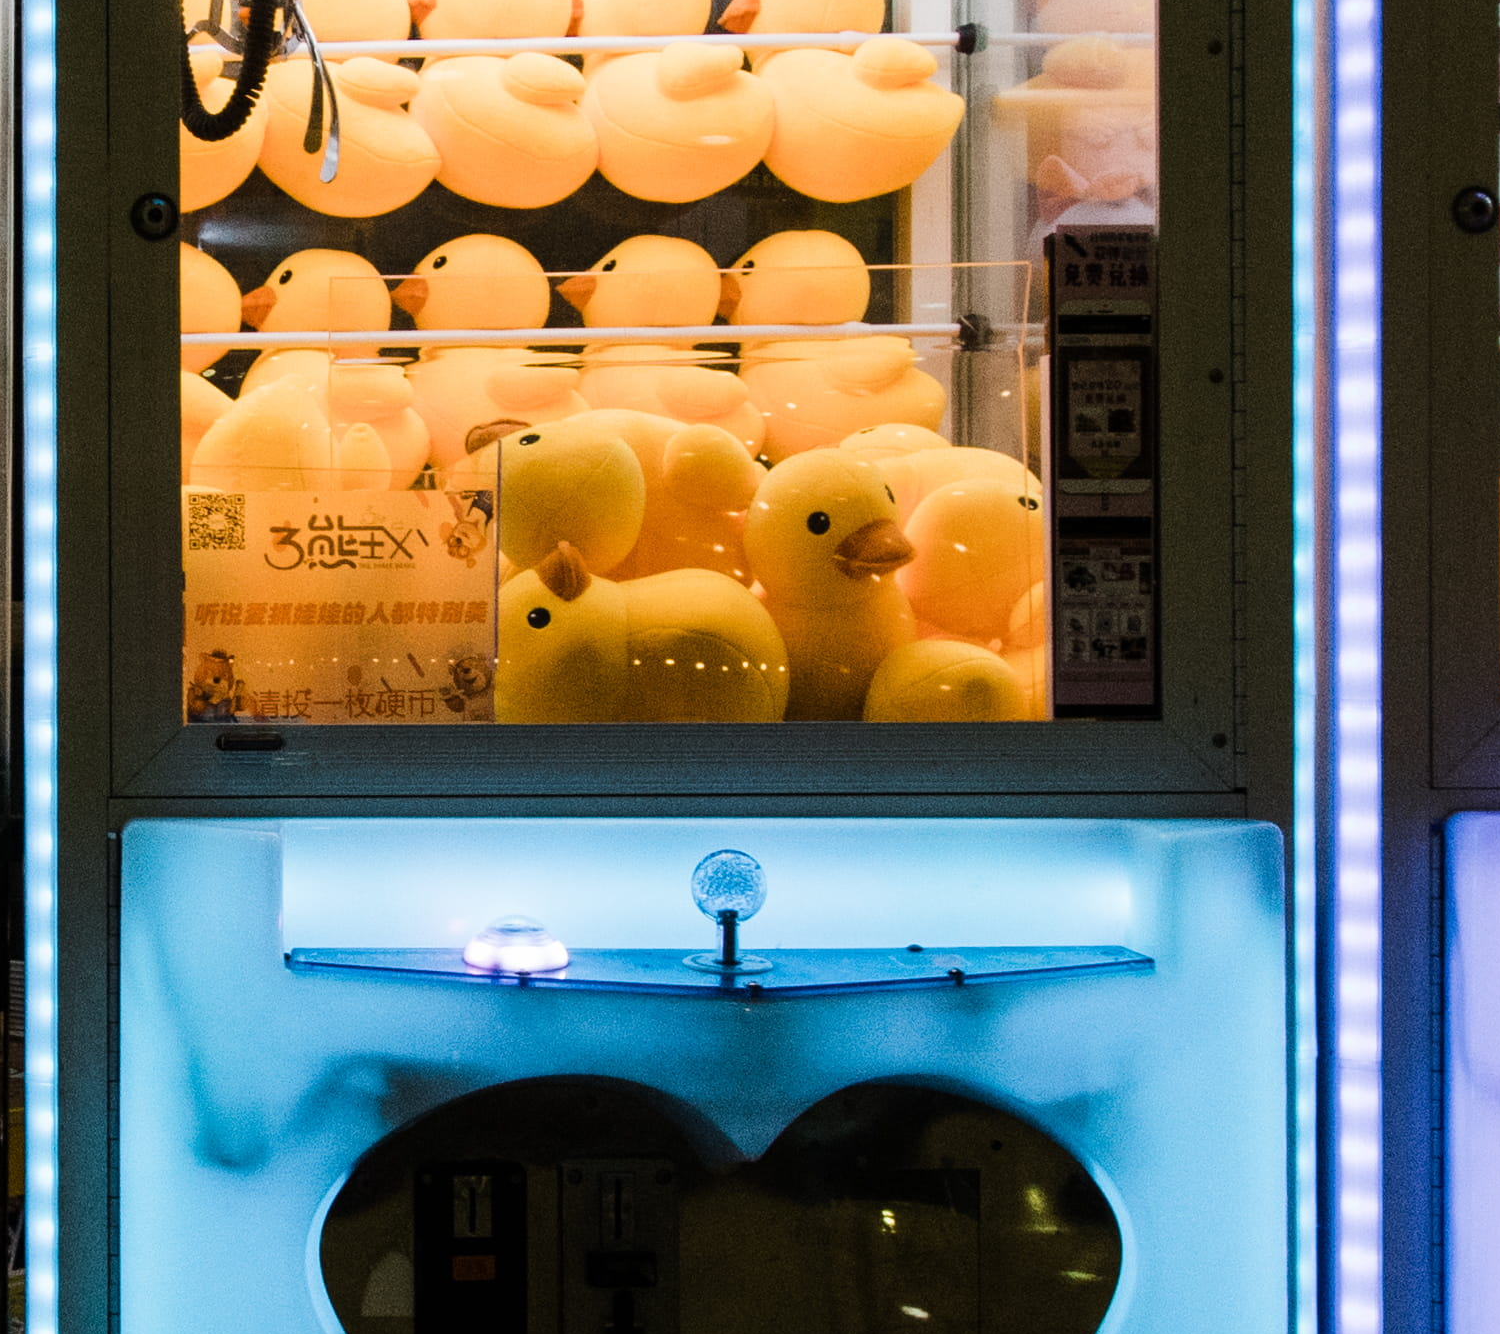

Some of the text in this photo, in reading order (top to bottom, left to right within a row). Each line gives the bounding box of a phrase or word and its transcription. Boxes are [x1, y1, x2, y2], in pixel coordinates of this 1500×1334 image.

[195, 601, 489, 626] 听说爱抓娃娃的人都特别美
[252, 689, 436, 719] 请投一枚硬币
